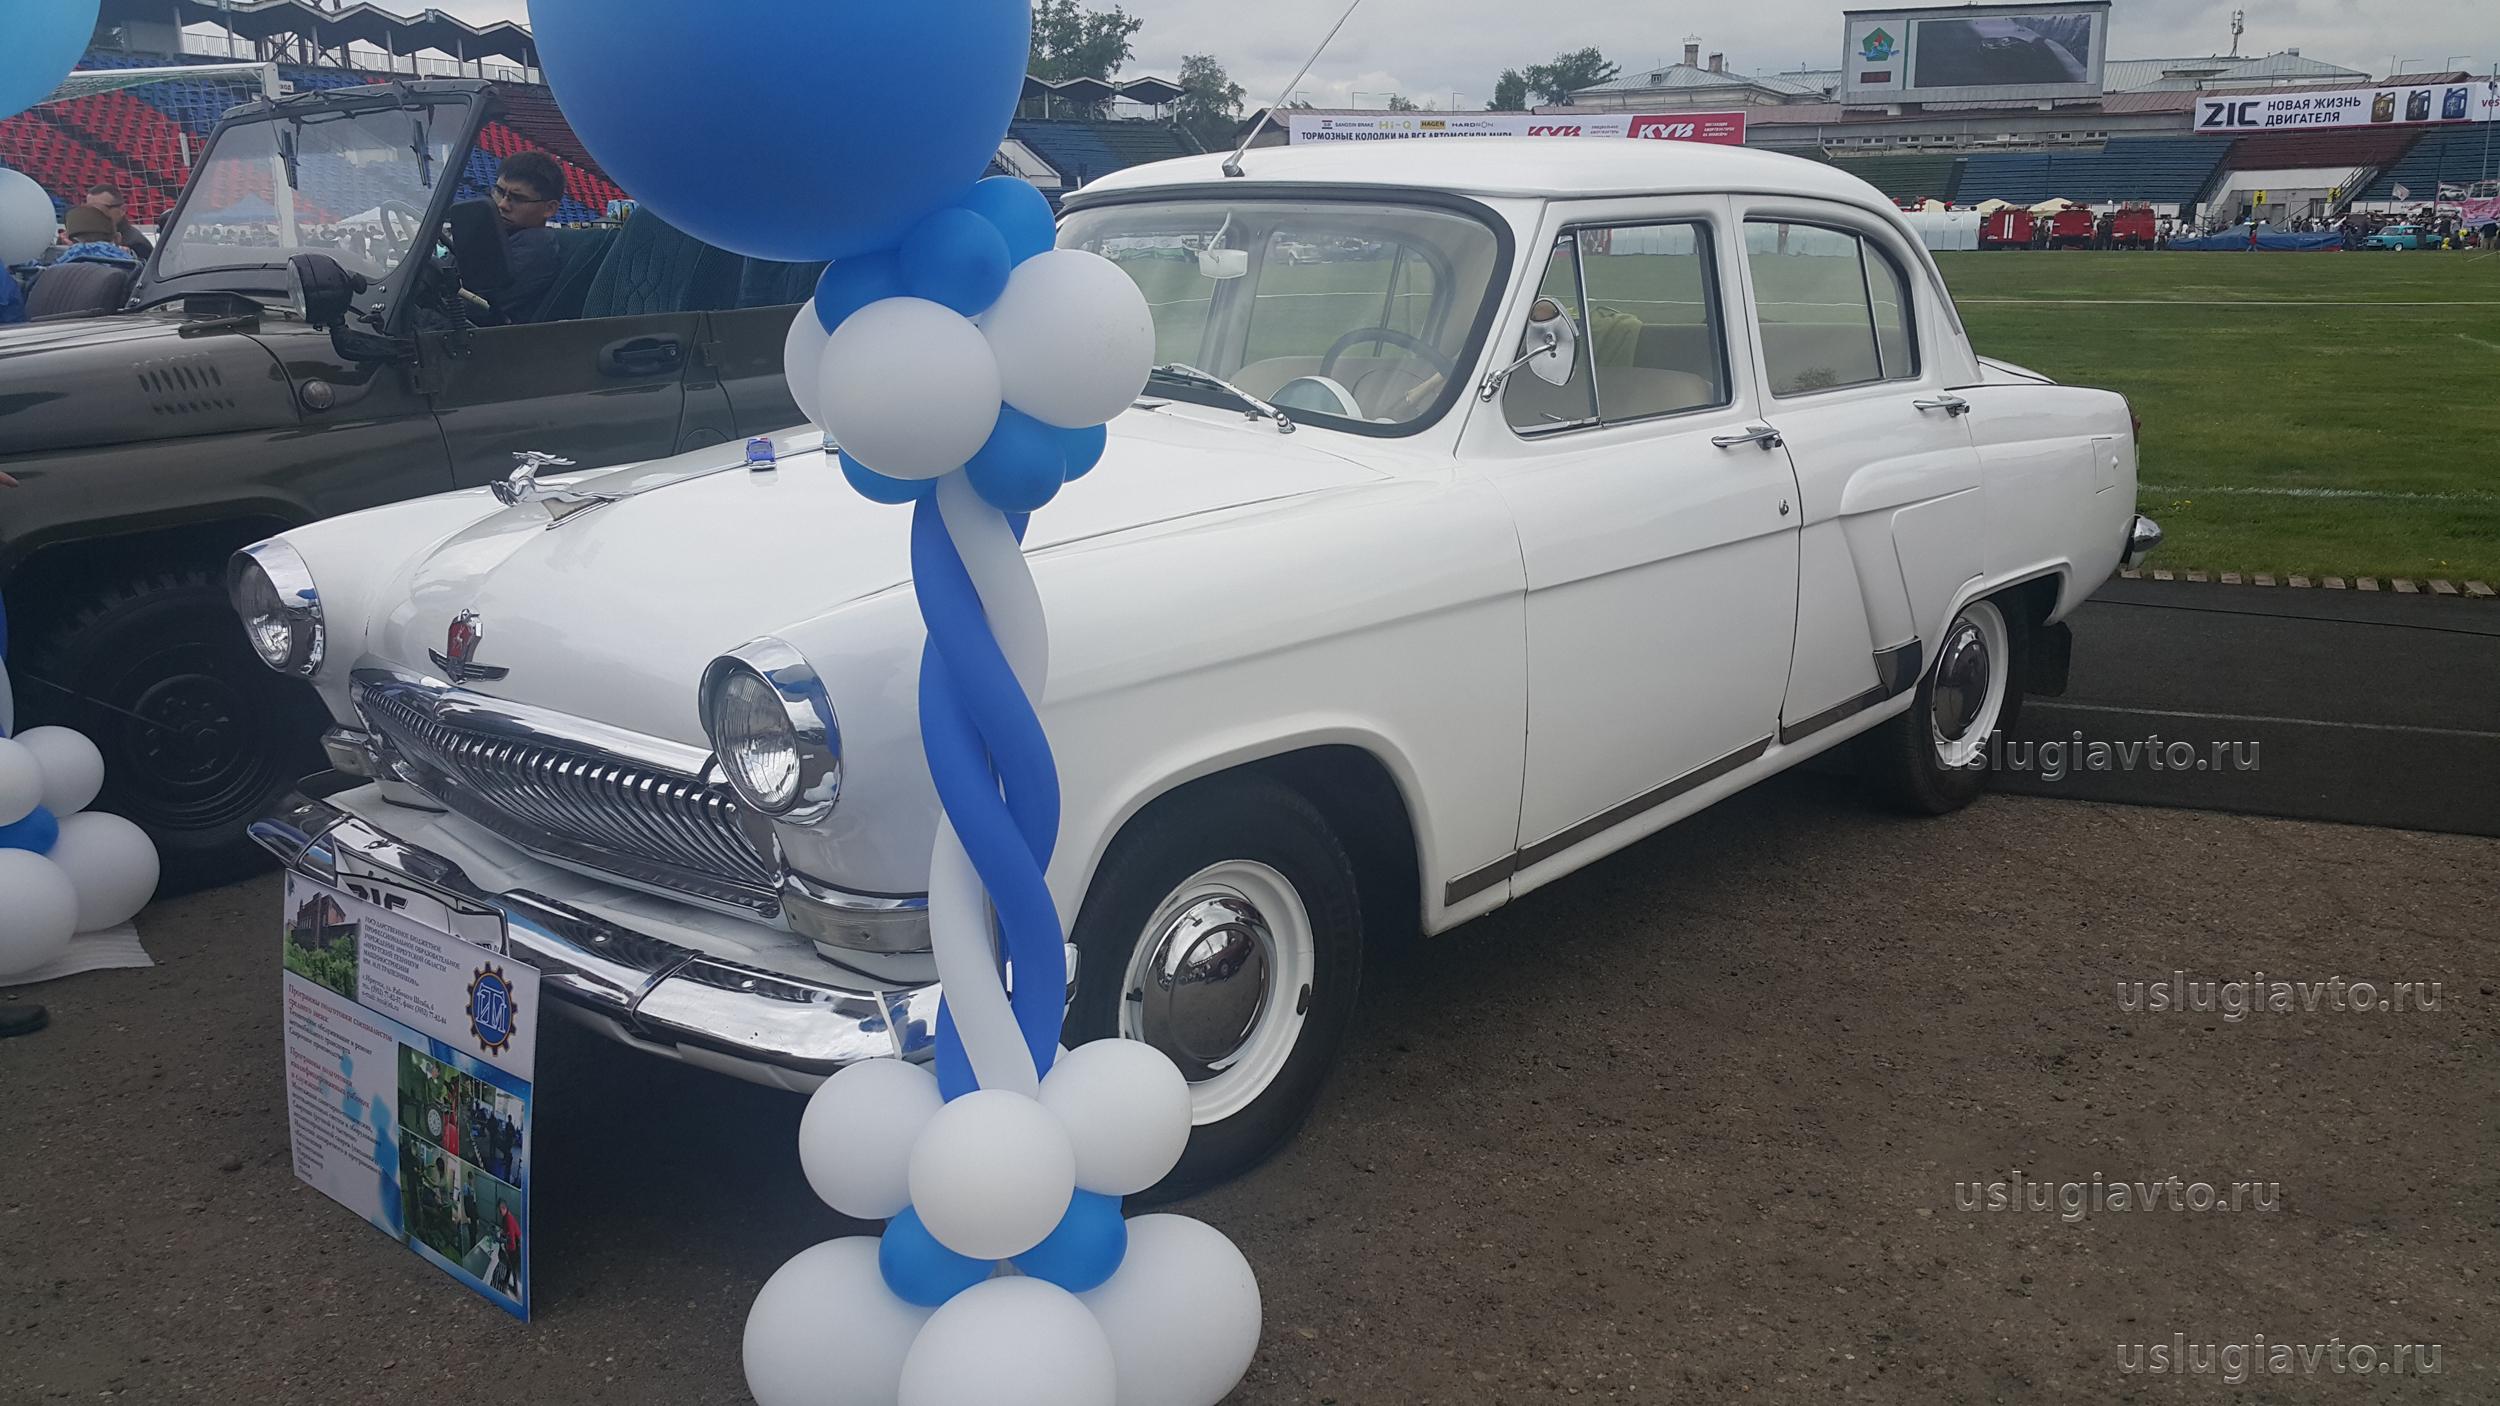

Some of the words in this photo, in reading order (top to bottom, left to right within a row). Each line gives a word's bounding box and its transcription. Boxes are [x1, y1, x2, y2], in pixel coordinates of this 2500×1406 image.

[2267, 99, 2311, 112] НОВАЯ
[2313, 96, 2361, 109] ЖИЗНЬ
[2201, 101, 2261, 128] ZIC
[2265, 111, 2340, 127] ДВИГАТЕЛЯ
[1301, 131, 1353, 141] ТОРМОЗНЫЕ
[1638, 123, 1696, 139] KYB
